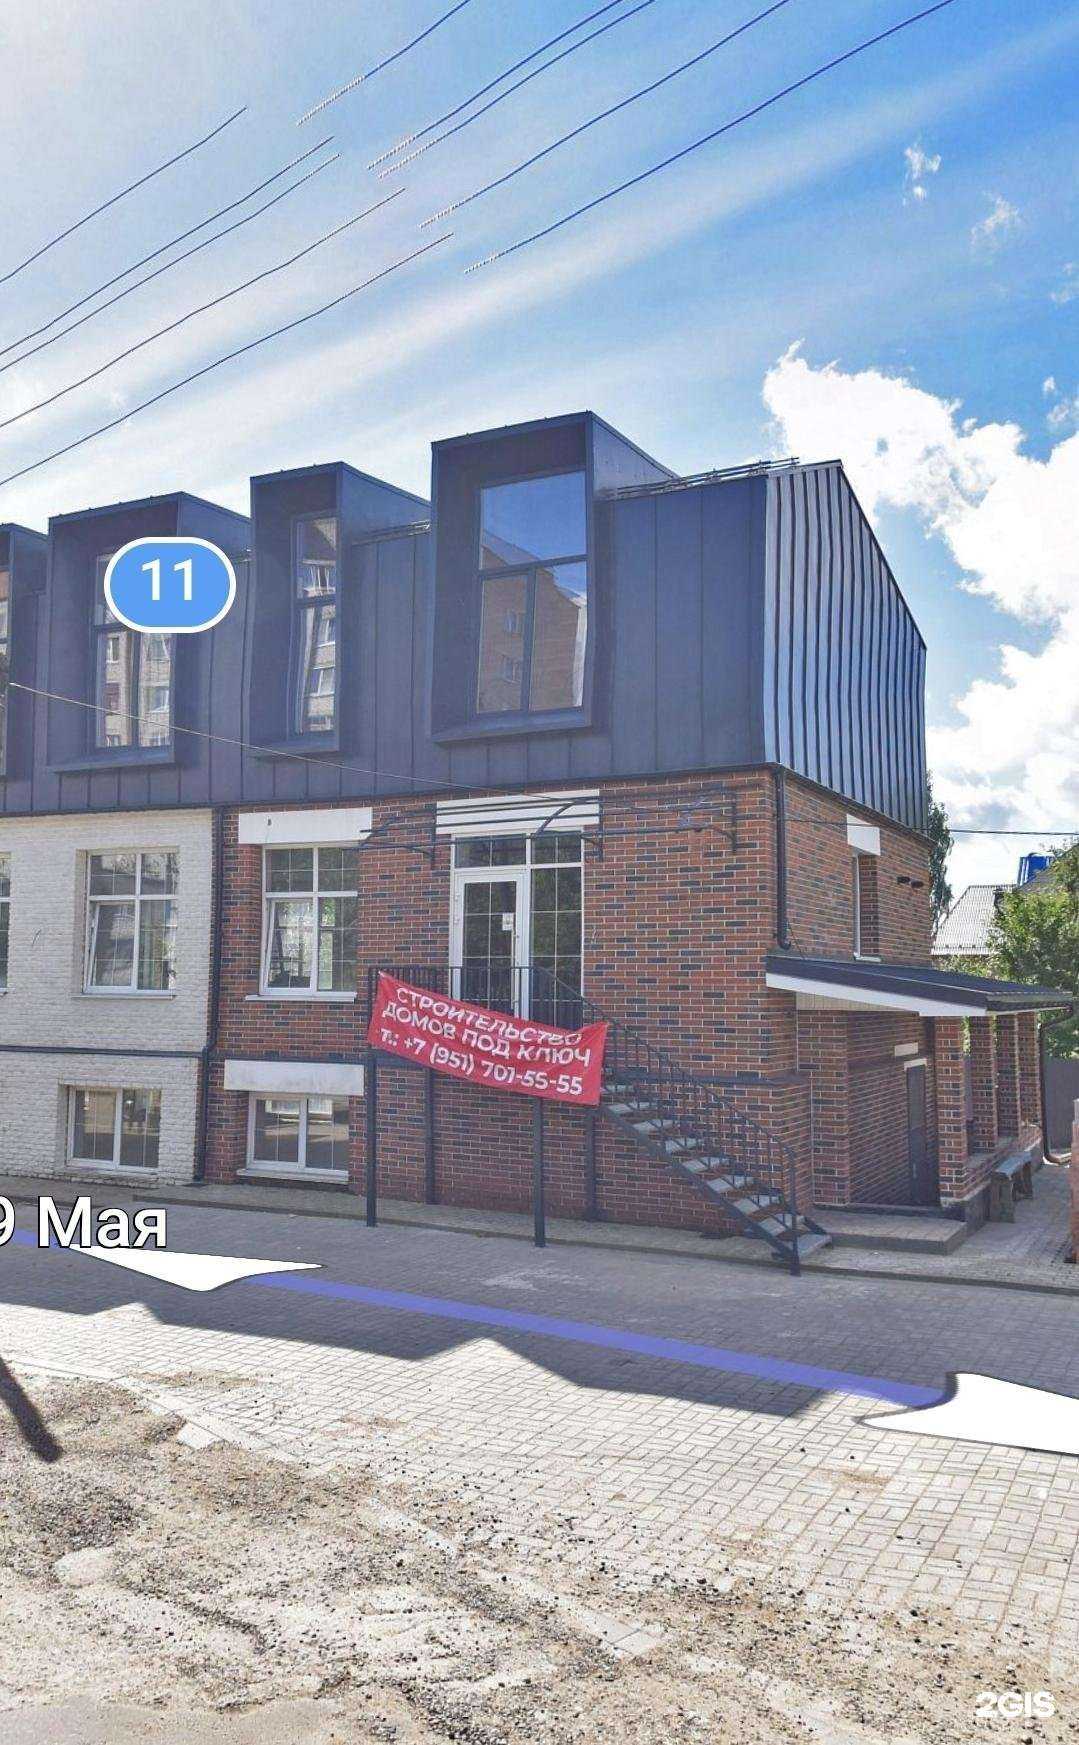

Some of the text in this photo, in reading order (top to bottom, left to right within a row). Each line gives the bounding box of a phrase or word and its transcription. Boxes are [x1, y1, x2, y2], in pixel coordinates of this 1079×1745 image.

[381, 1002, 591, 1067] ДОМОВ ПОД КЛЮЧ
[396, 987, 582, 1046] СТРОИТЕЛЬСТВО
[404, 1036, 426, 1055] +7
[429, 1042, 475, 1075] (951)
[481, 1060, 583, 1096] 701-55-55
